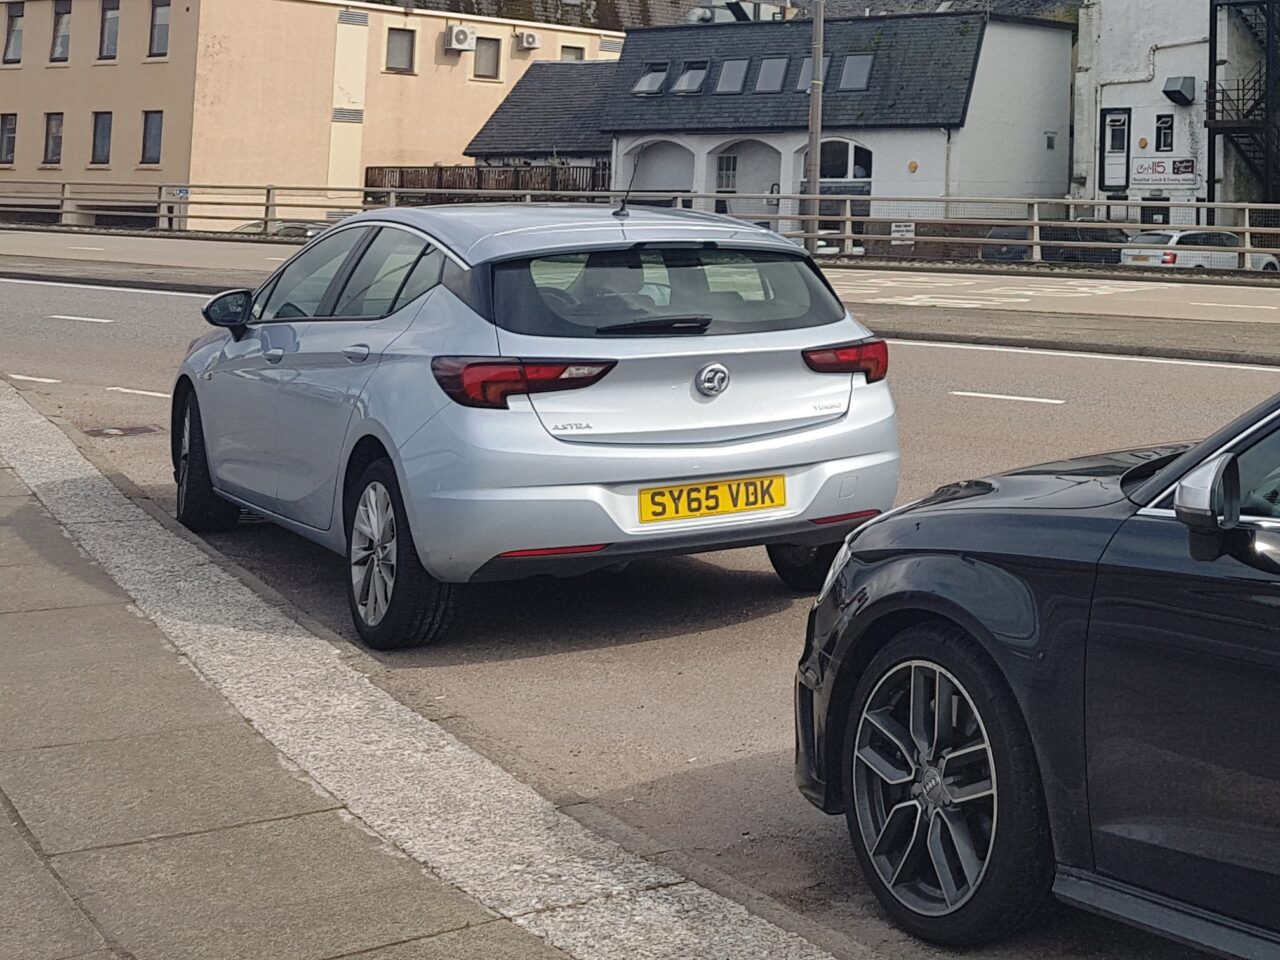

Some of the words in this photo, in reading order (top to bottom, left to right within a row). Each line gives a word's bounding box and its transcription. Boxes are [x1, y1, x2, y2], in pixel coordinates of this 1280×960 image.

[552, 422, 593, 431] ASTRA
[650, 485, 720, 517] SY65
[728, 479, 775, 508] VDK
